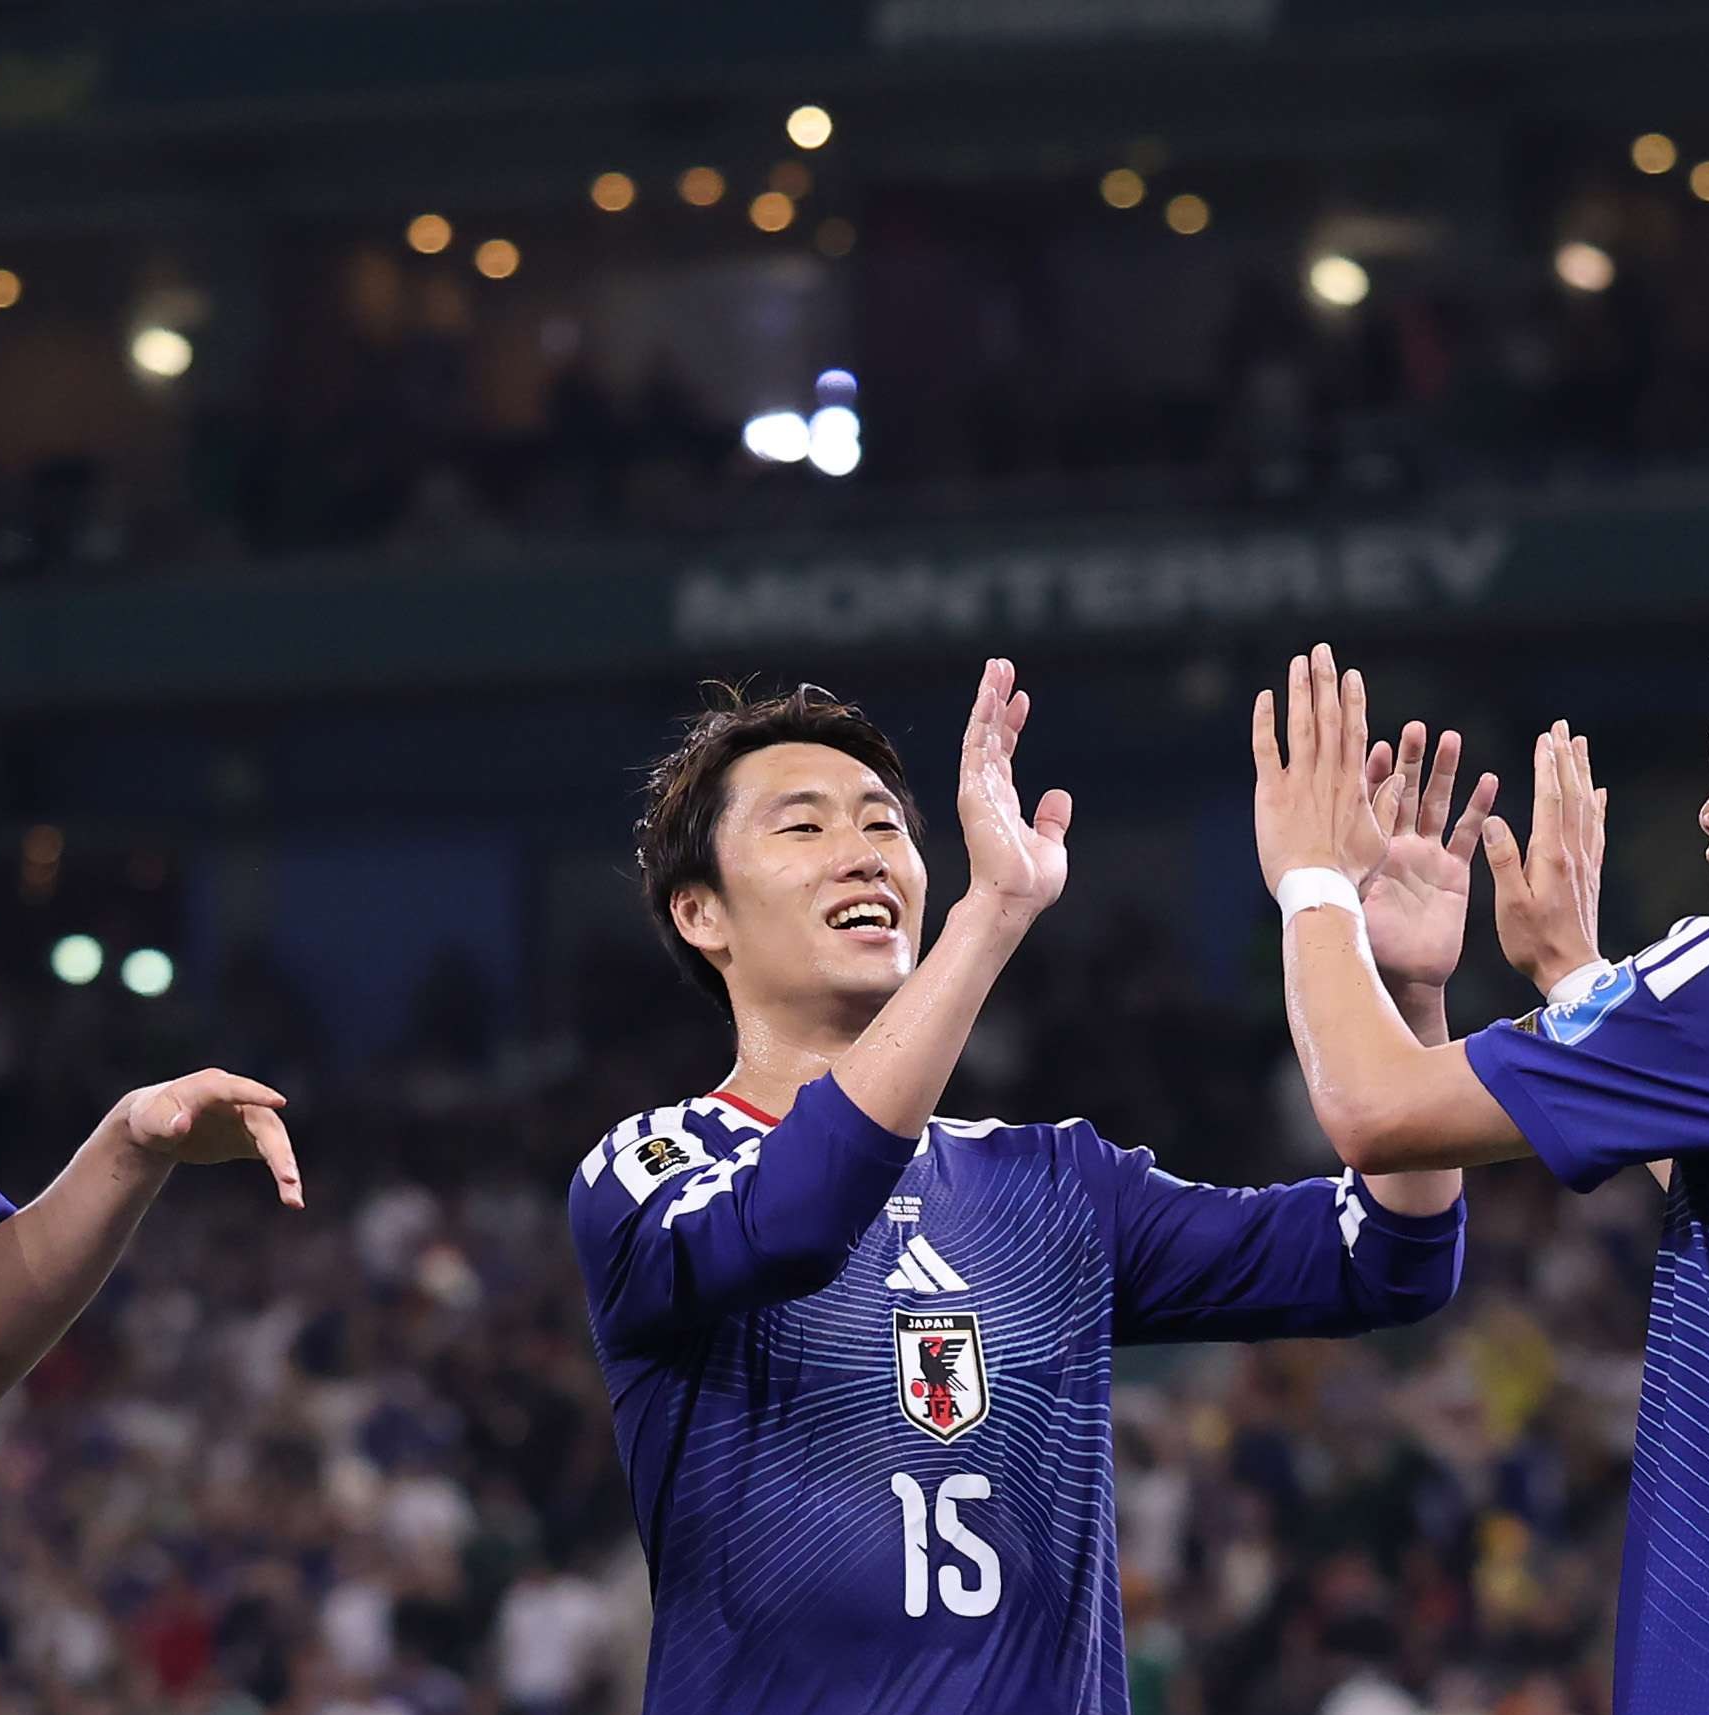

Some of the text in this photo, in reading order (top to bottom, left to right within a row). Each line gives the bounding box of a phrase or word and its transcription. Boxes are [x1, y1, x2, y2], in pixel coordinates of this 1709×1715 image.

[675, 524, 1511, 645] MONTERREY
[908, 1318, 954, 1329] JAPAN
[890, 1473, 1002, 1618] 15
